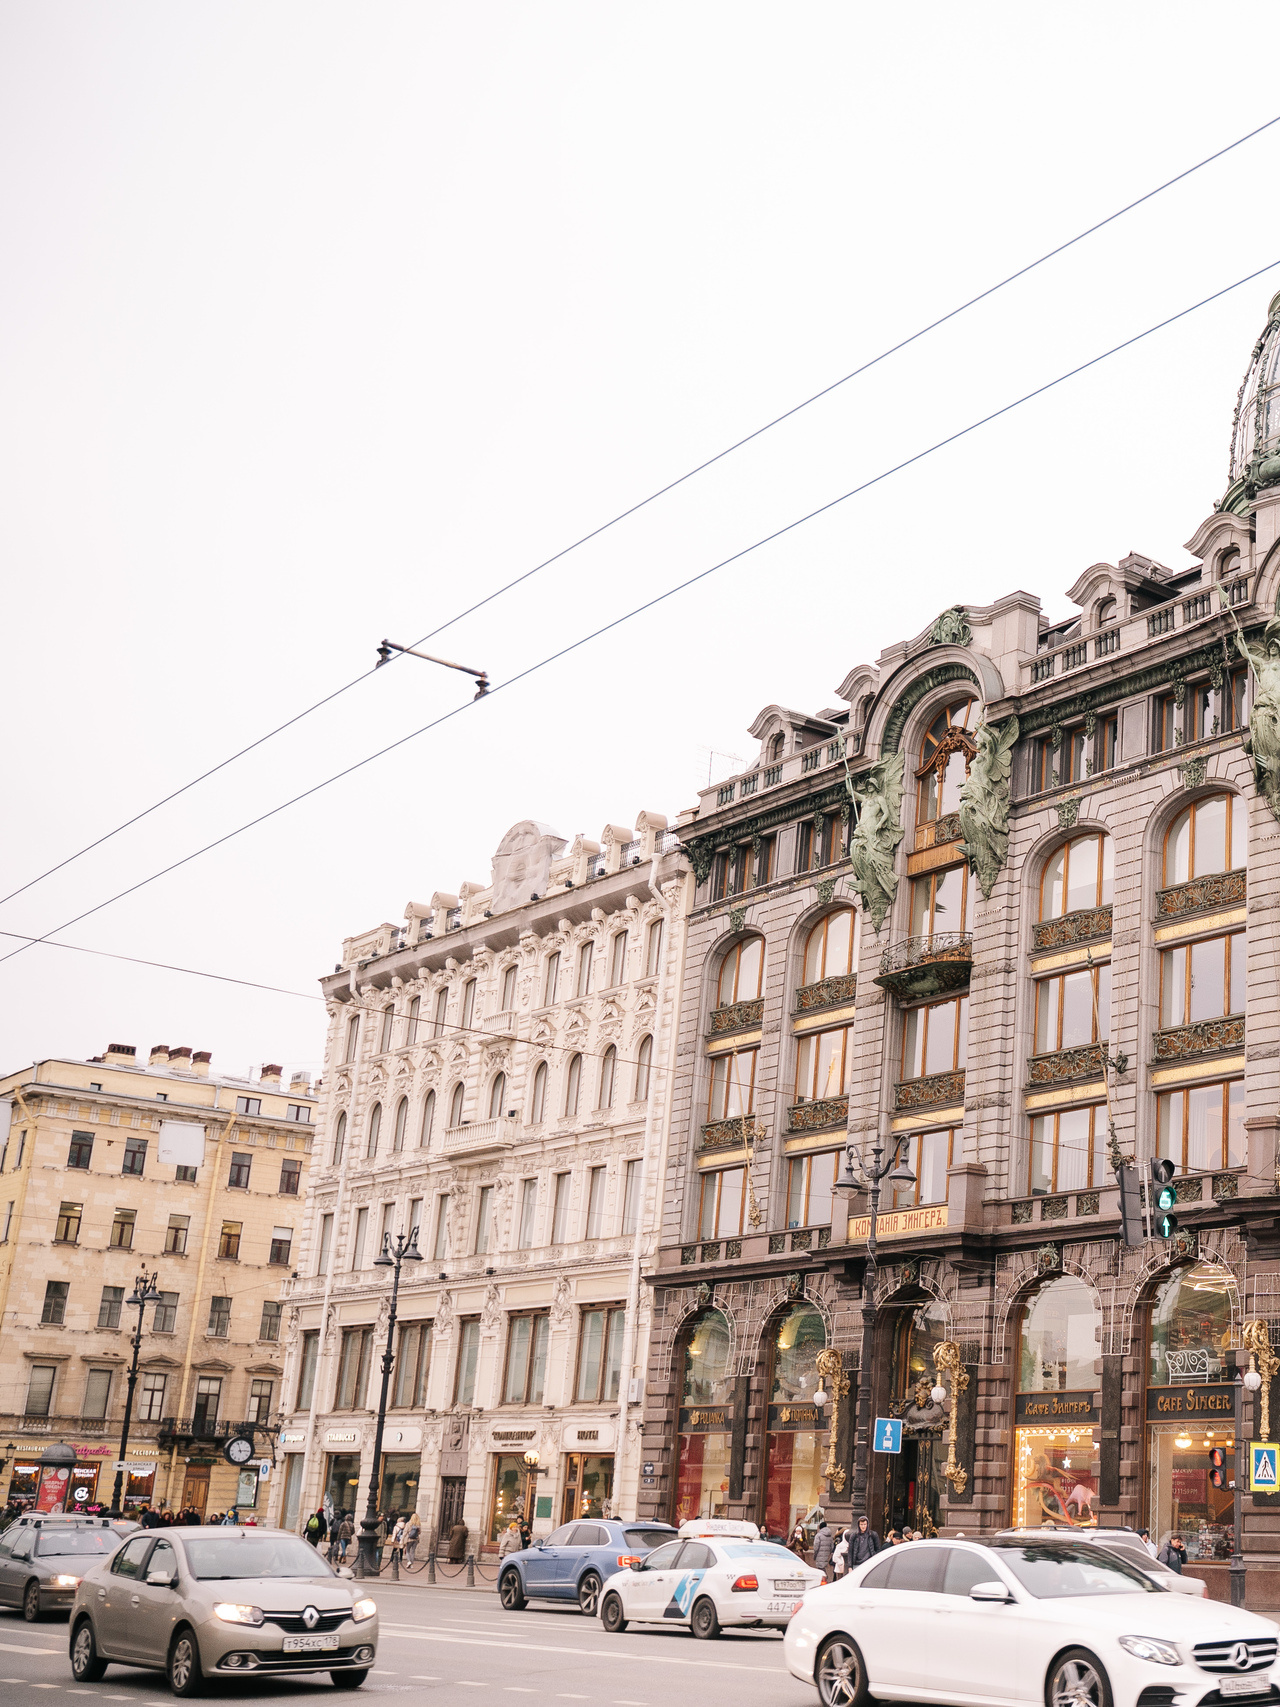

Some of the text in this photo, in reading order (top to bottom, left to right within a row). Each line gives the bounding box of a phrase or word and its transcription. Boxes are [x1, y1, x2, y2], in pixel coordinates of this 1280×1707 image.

[1157, 1389, 1232, 1412] CAFE SINGER
[324, 1636, 338, 1645] 178
